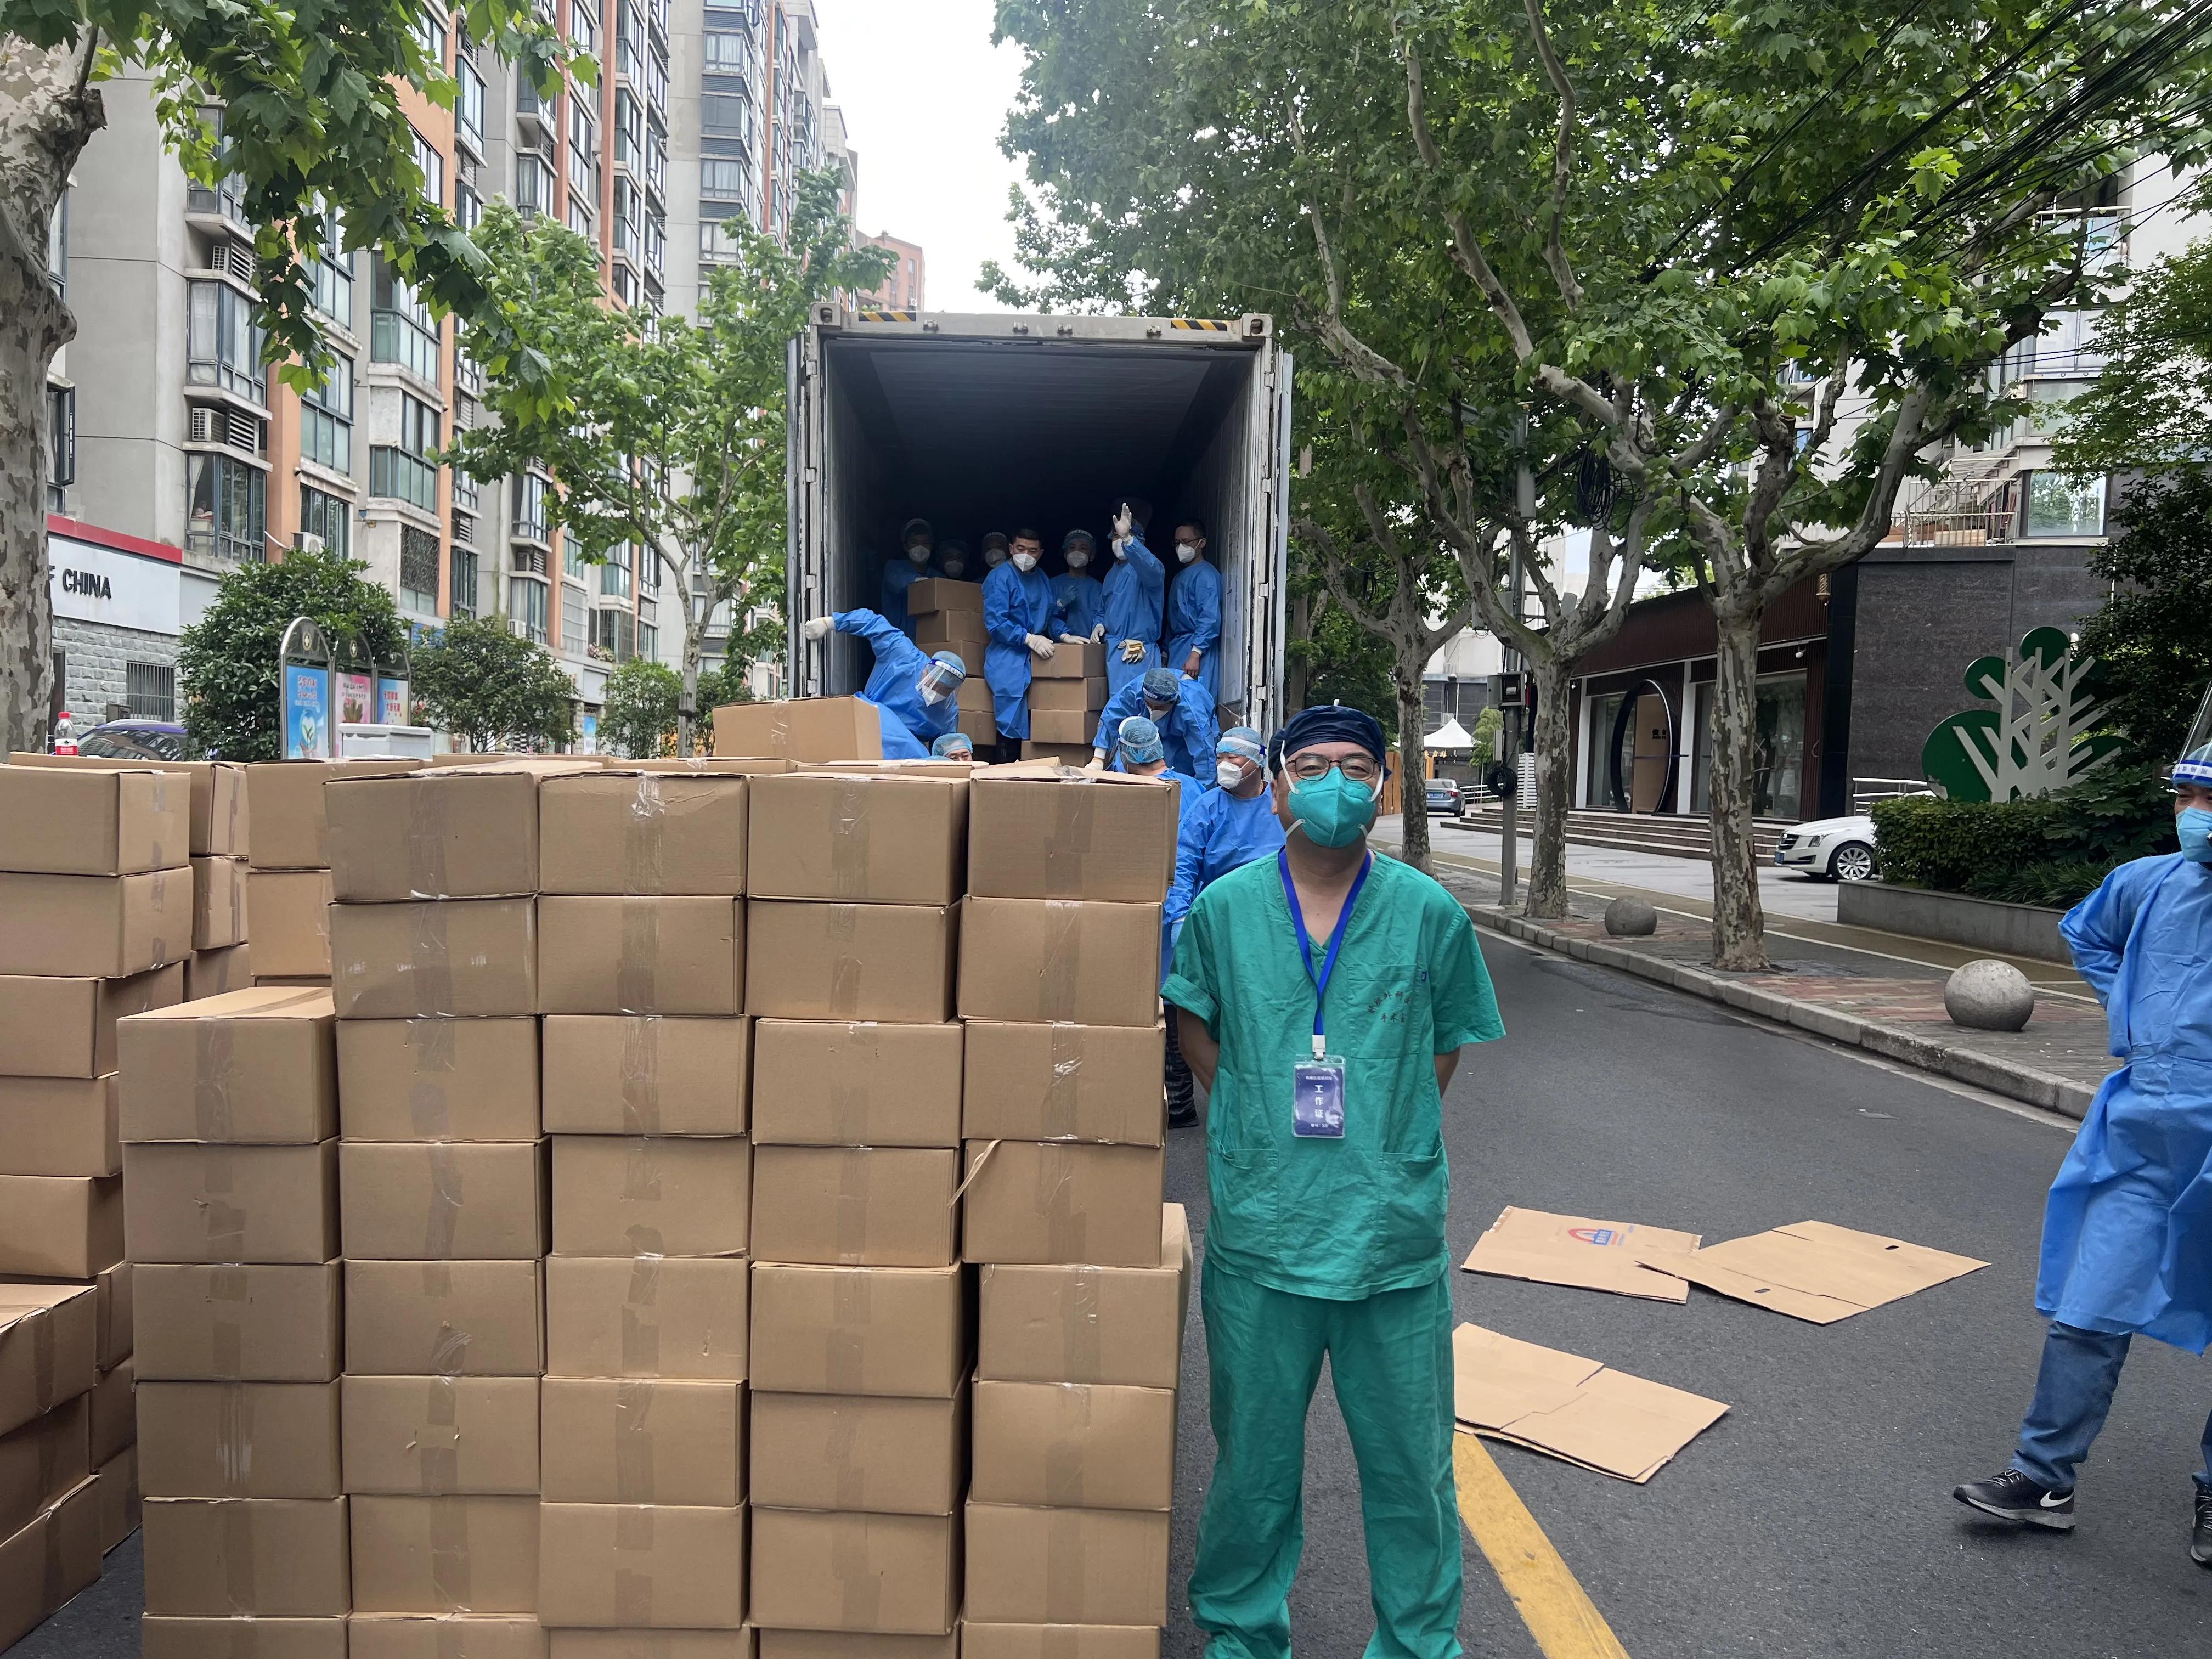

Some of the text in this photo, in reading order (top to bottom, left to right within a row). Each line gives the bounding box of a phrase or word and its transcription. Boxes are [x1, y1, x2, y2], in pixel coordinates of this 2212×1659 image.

[62, 568, 111, 600] CHINA
[1314, 1085, 1324, 1118] 工作证
